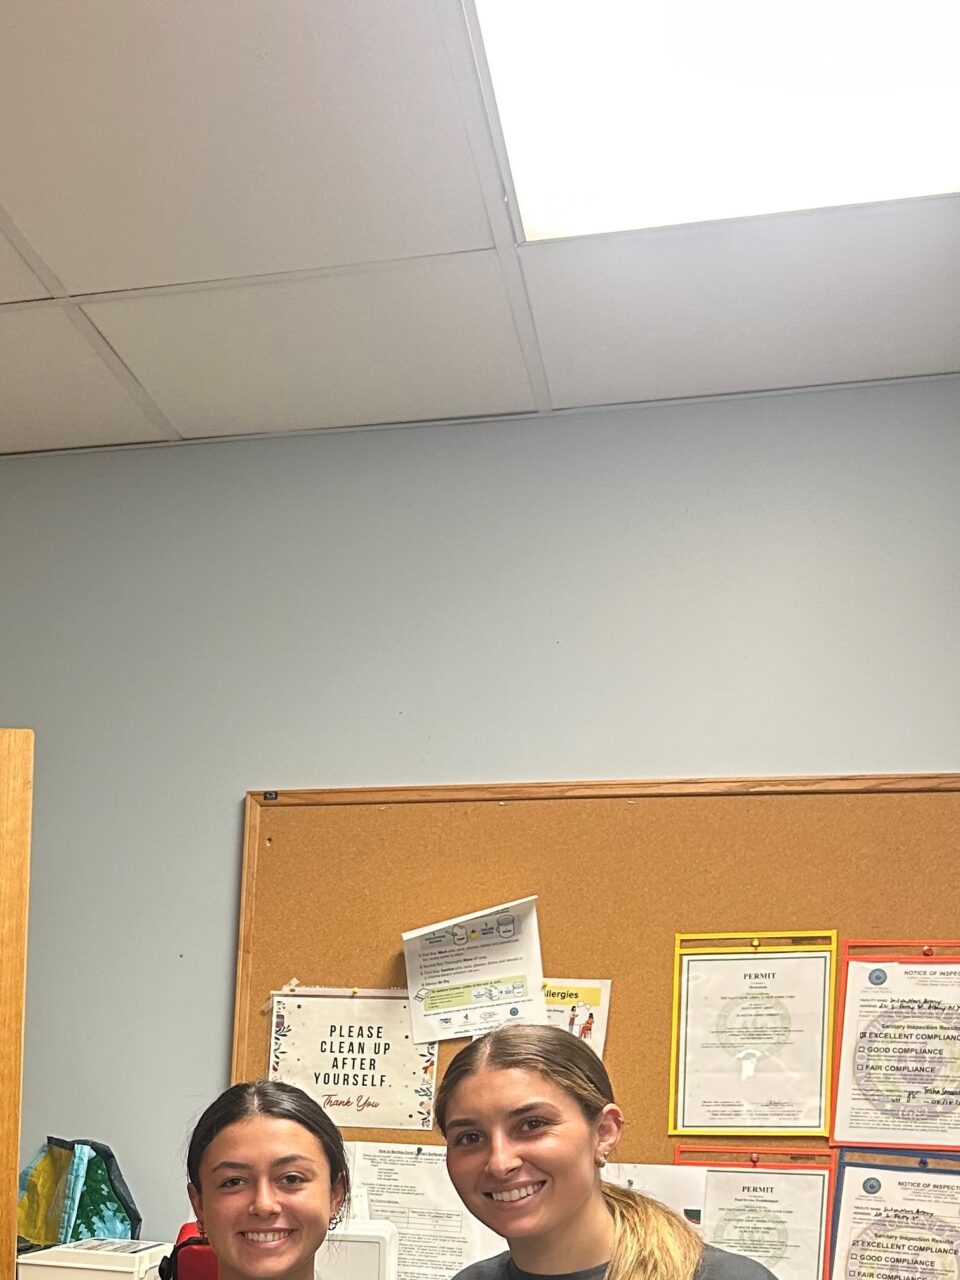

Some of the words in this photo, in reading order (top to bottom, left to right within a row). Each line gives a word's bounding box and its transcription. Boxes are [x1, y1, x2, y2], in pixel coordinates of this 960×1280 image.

[743, 972, 776, 980] PERMIT
[329, 1025, 383, 1038] PLEASE
[320, 1041, 365, 1054] CLEAN
[374, 1042, 390, 1055] UP
[331, 1057, 376, 1070] AFTER
[884, 1065, 936, 1073] COMPLIANCE
[314, 1072, 391, 1087] YOURSELF.
[322, 1094, 353, 1108] Thank
[356, 1094, 380, 1111] You
[742, 1185, 775, 1193] PERMIT
[861, 1240, 906, 1249] EXCELLENT
[908, 1245, 960, 1255] COMPLIANCE
[884, 1256, 936, 1267] COMPLIANCE
